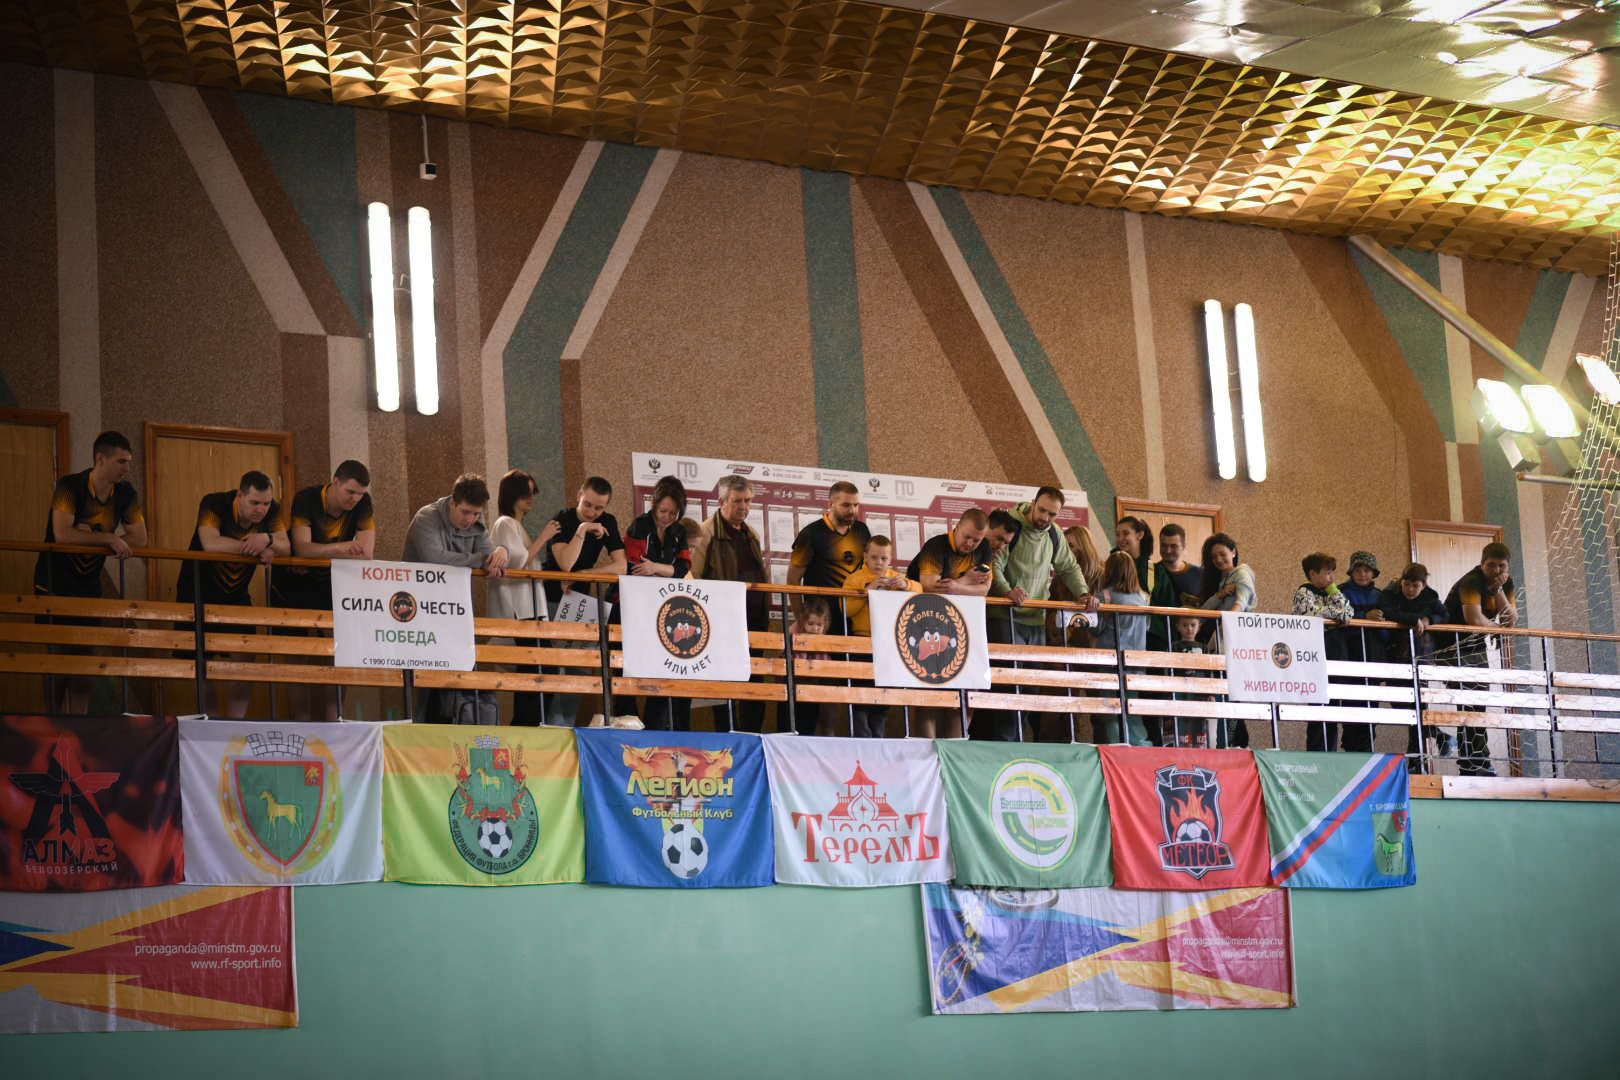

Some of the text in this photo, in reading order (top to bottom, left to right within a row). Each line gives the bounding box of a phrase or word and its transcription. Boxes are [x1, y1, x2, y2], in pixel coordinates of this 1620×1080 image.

[677, 461, 698, 478] ГТО
[362, 567, 446, 584] КОЛЕТ БОК
[658, 582, 709, 604] ПОБЕДА
[341, 597, 466, 615] СИЛА ЧЕСТЬ
[560, 602, 571, 619] БОК
[912, 610, 934, 623] КОЛЕТ
[1237, 616, 1311, 631] ПОЙ ГРОМКО
[375, 629, 437, 647] ПОБЕДА
[362, 657, 450, 669] С 1990 ГОДА (ПОЧТИ ВСЕ)
[1232, 648, 1319, 662] КОЛЕТ БОК
[664, 654, 712, 675] ИЛИ НЕТ
[1243, 680, 1317, 695] ЖИВИ ГОРДО
[1177, 775, 1194, 786] ФК
[704, 806, 734, 819] Клуб
[24, 838, 117, 864] АЛМАЗ
[1163, 843, 1229, 866] МЕТЕОР
[135, 942, 281, 956] propaganda@minstm.gov.ru
[191, 957, 282, 970] www.rf-sport.info
